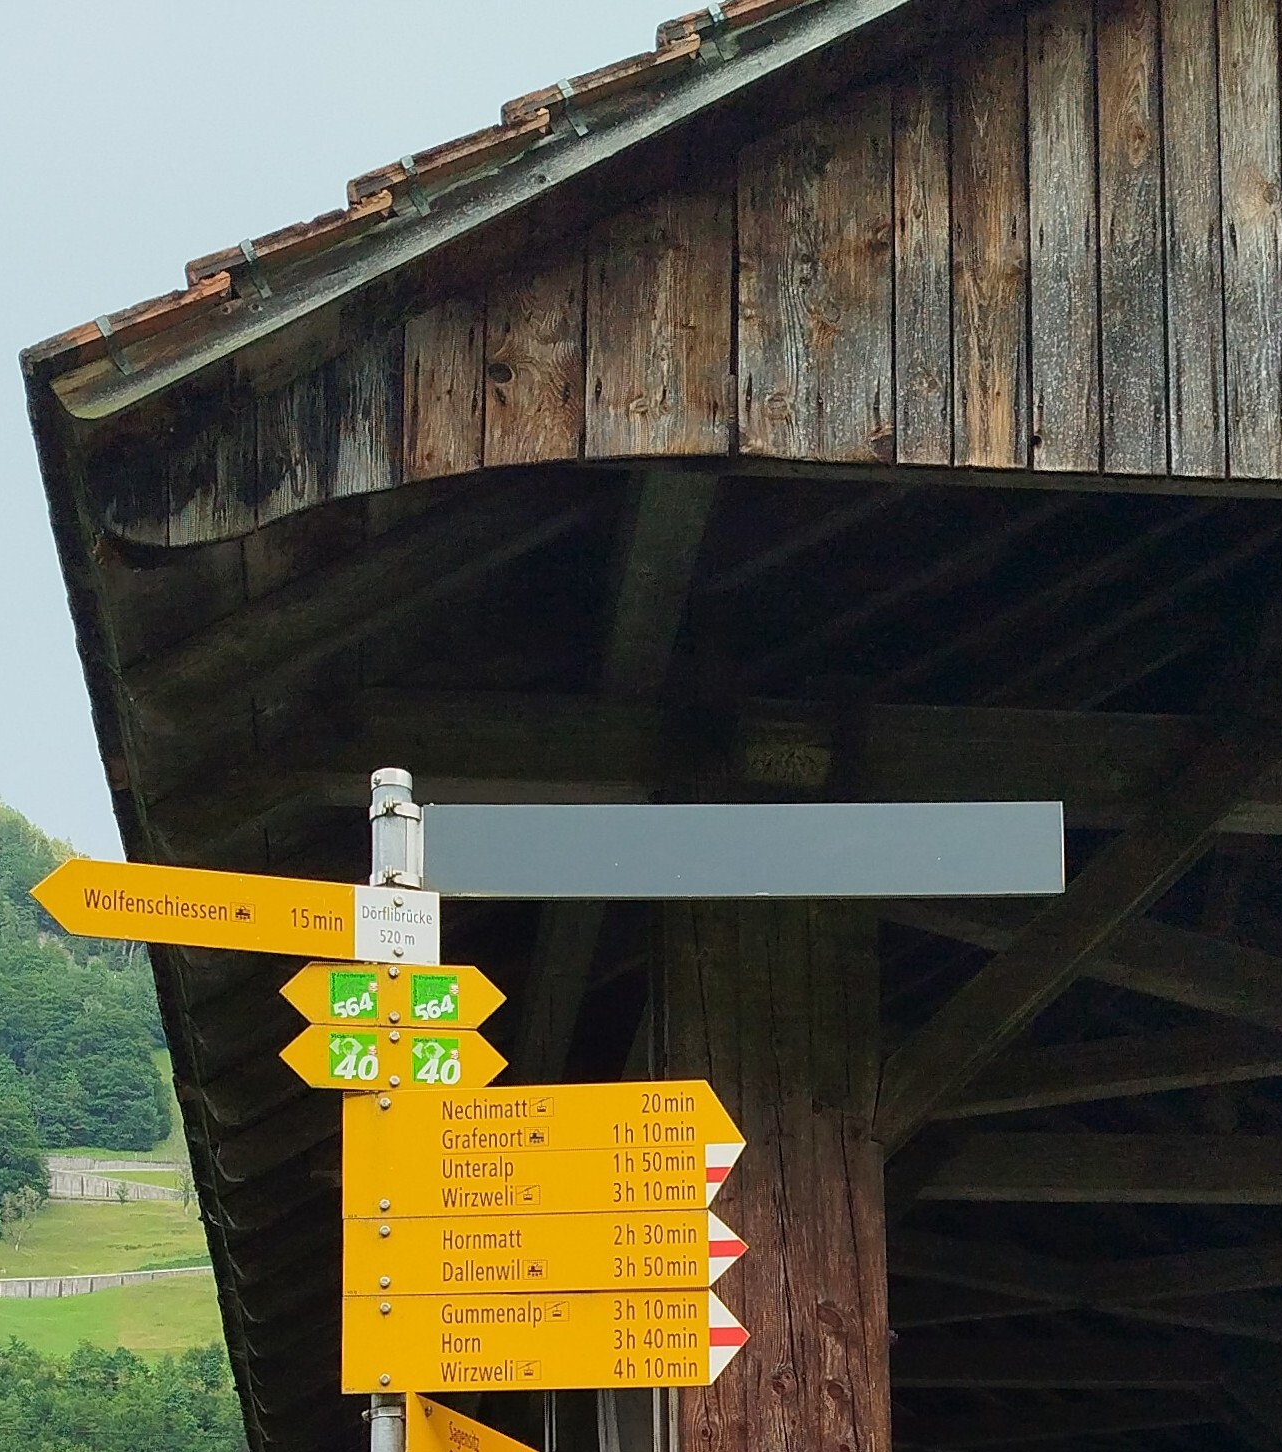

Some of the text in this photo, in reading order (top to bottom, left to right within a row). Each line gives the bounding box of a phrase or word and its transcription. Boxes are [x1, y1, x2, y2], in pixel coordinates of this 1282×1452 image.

[83, 888, 228, 921] Wolfenschiessen
[361, 904, 433, 926] Dörflibrücke
[379, 929, 415, 946] 520 m
[333, 992, 374, 1018] 564
[415, 994, 455, 1021] 564
[334, 1055, 379, 1081] 40
[417, 1058, 461, 1085] 40
[441, 1099, 528, 1121] Nechimatt
[441, 1128, 524, 1150] Grafenort
[441, 1156, 514, 1181] Unteralp
[441, 1186, 514, 1209] Wirzweli
[442, 1229, 522, 1251] Hornmatt
[442, 1259, 521, 1283] Dallenwil
[441, 1301, 543, 1328] Gummenalp
[441, 1332, 481, 1355] Horn
[441, 1360, 514, 1384] Wirzweli
[448, 1420, 480, 1452] Sagensitz
